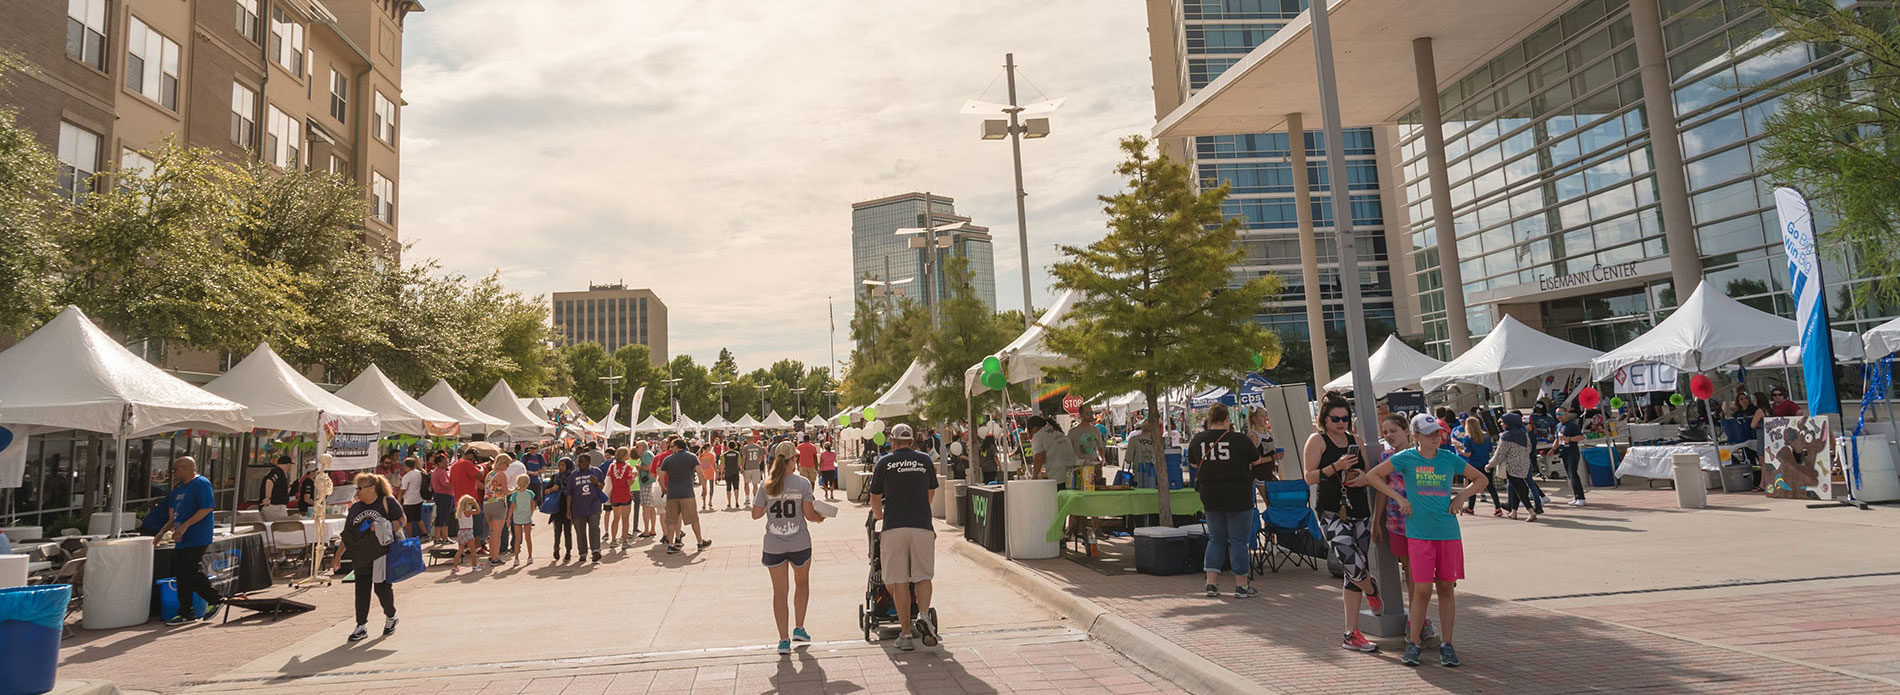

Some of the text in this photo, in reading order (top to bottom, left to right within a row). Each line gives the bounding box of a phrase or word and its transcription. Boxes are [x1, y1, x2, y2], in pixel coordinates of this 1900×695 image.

[1786, 221, 1814, 255] Go Big
[1784, 235, 1812, 274] Win Big
[1592, 263, 1638, 282] CENTER
[1630, 362, 1676, 386] ETC
[1064, 399, 1082, 408] STOP
[1138, 438, 1153, 447] vpa
[1200, 441, 1231, 461] 115
[749, 451, 758, 462] 16
[886, 459, 917, 470] Serving
[896, 466, 927, 474] Community
[582, 484, 590, 493] G
[769, 500, 797, 519] 40
[971, 494, 989, 527] vpay
